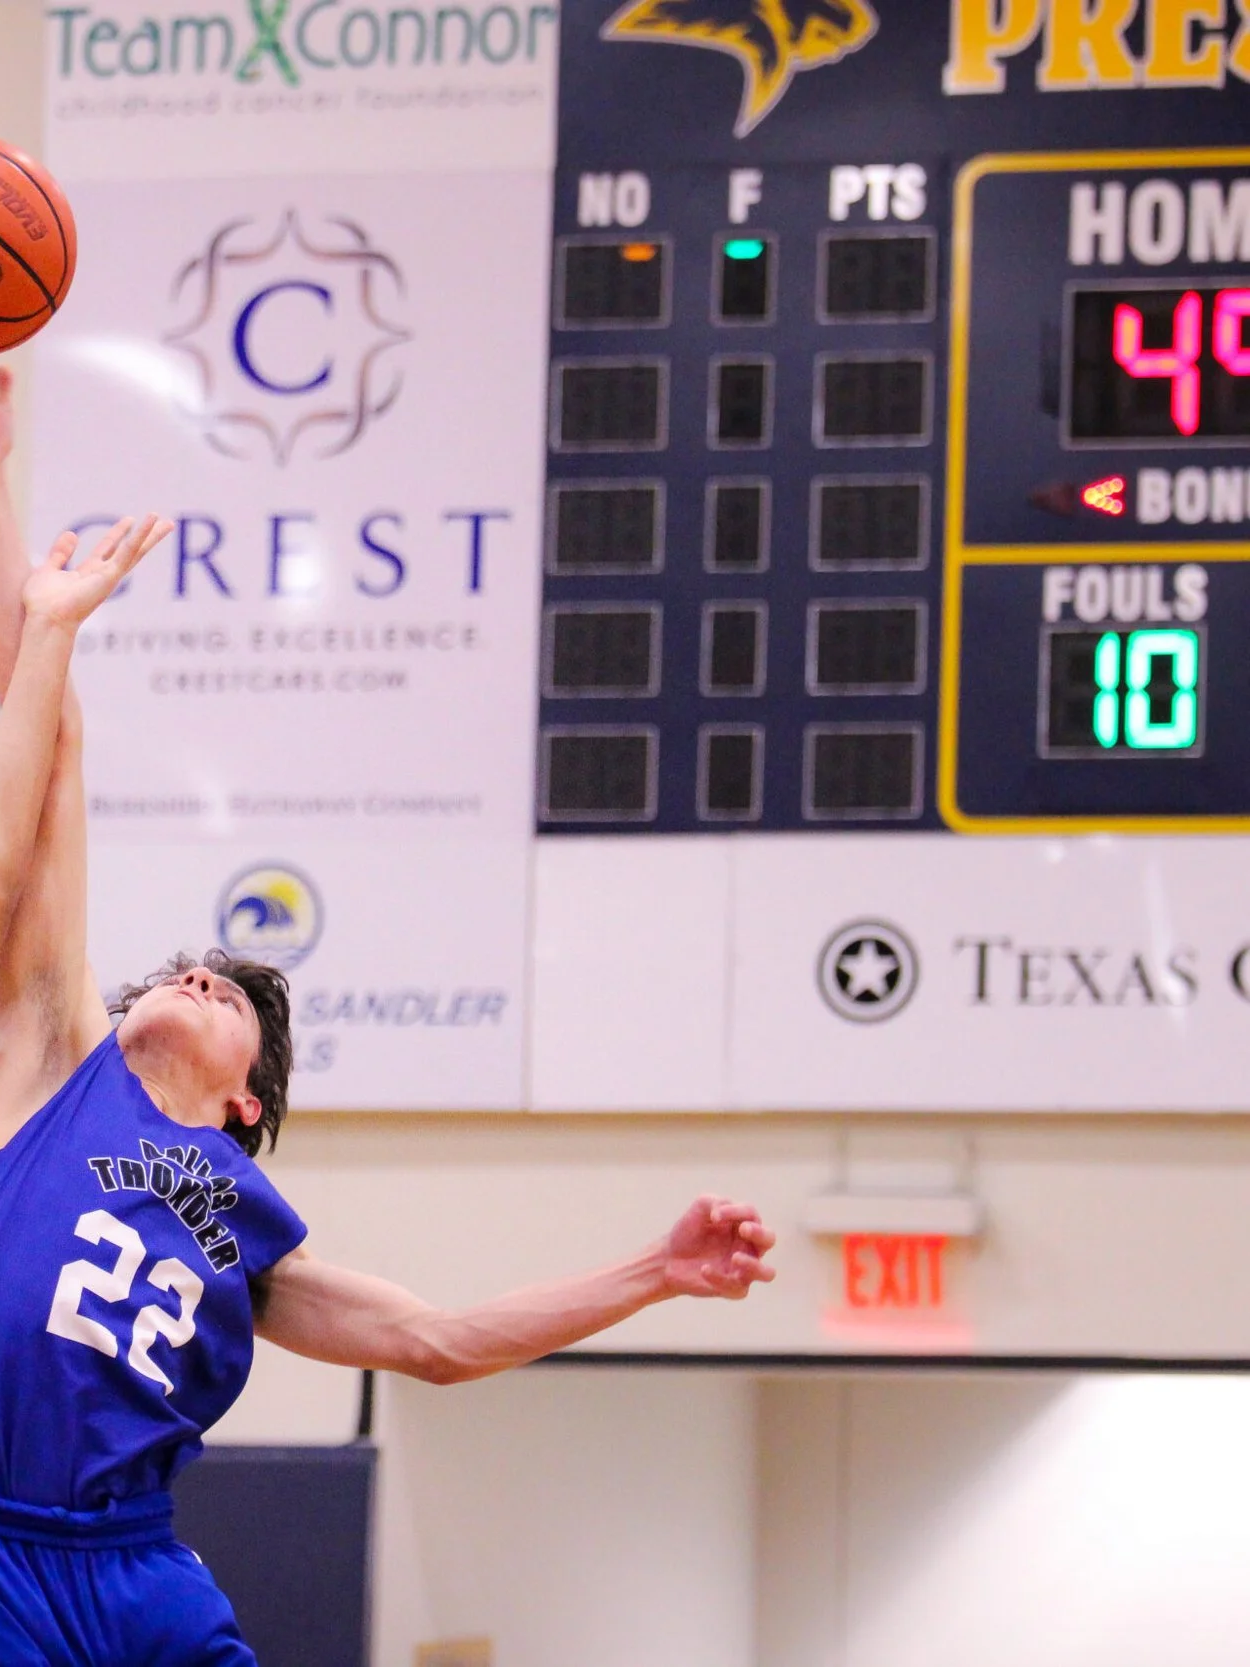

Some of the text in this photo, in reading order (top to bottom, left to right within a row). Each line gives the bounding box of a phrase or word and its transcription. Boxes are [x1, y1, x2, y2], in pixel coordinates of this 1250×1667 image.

[47, 0, 559, 80] Team Connor
[941, 0, 1250, 95] PRE
[576, 164, 928, 230] NO F PTS
[1136, 466, 1250, 525] BON
[1043, 563, 1208, 623] FOULS
[1092, 628, 1199, 750] 10
[299, 987, 507, 1026] SANDLER
[950, 934, 1200, 1007] TEXAS
[87, 1156, 241, 1275] THUNDER
[47, 1209, 206, 1397] 22
[844, 1232, 950, 1309] EXIT
